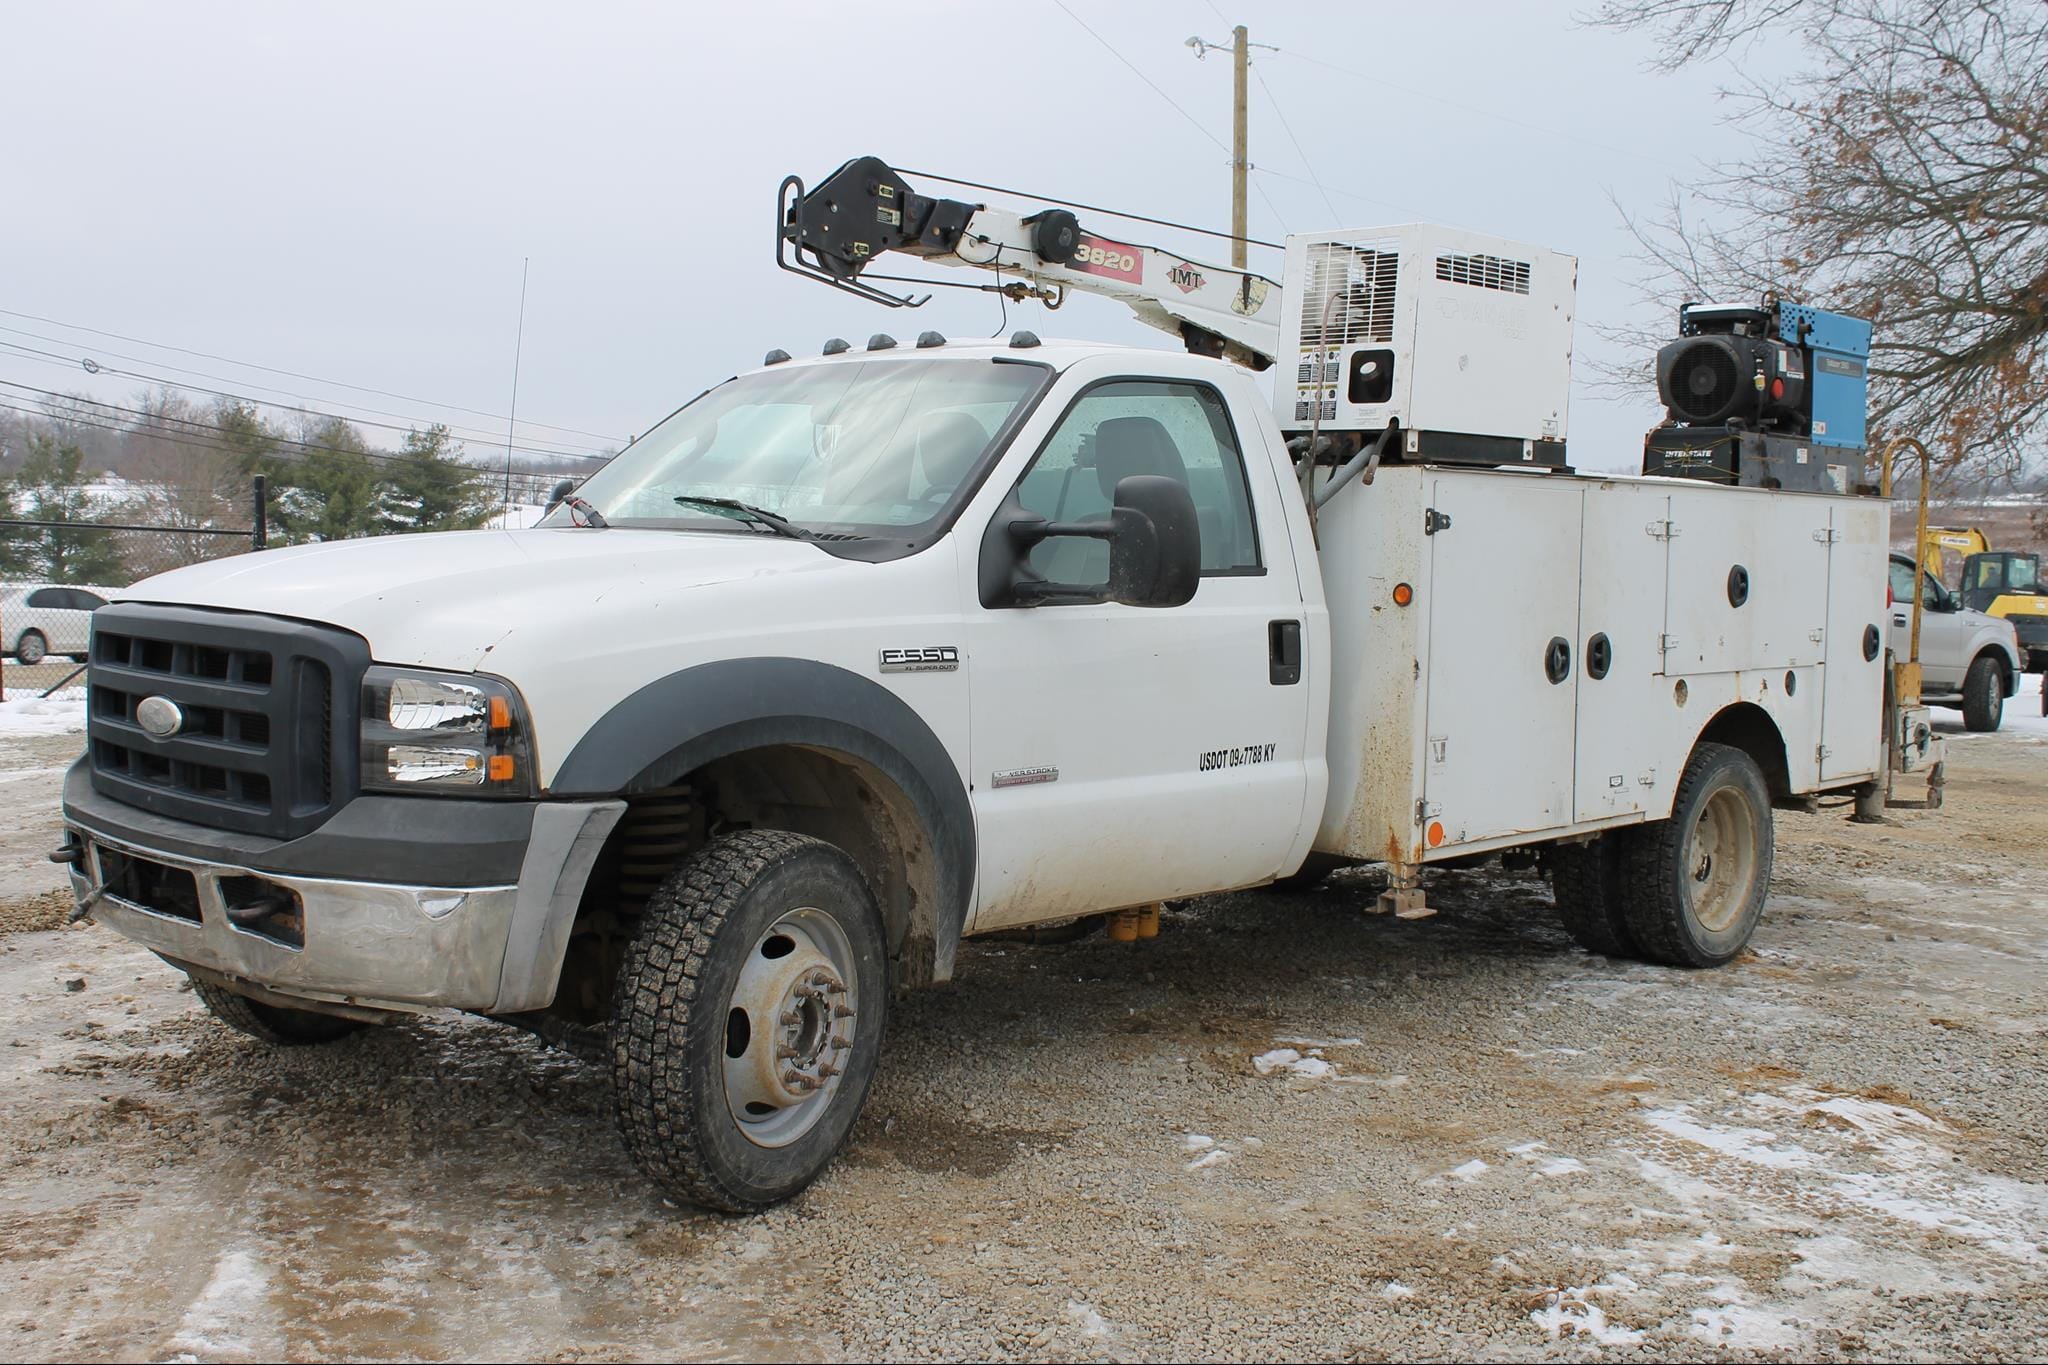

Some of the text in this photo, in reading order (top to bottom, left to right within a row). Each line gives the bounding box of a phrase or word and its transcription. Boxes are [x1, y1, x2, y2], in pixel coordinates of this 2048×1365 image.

[1074, 243, 1135, 272] 3820
[1171, 268, 1202, 289] IMT
[1199, 749, 1228, 772] USDOT
[1263, 742, 1277, 763] KY
